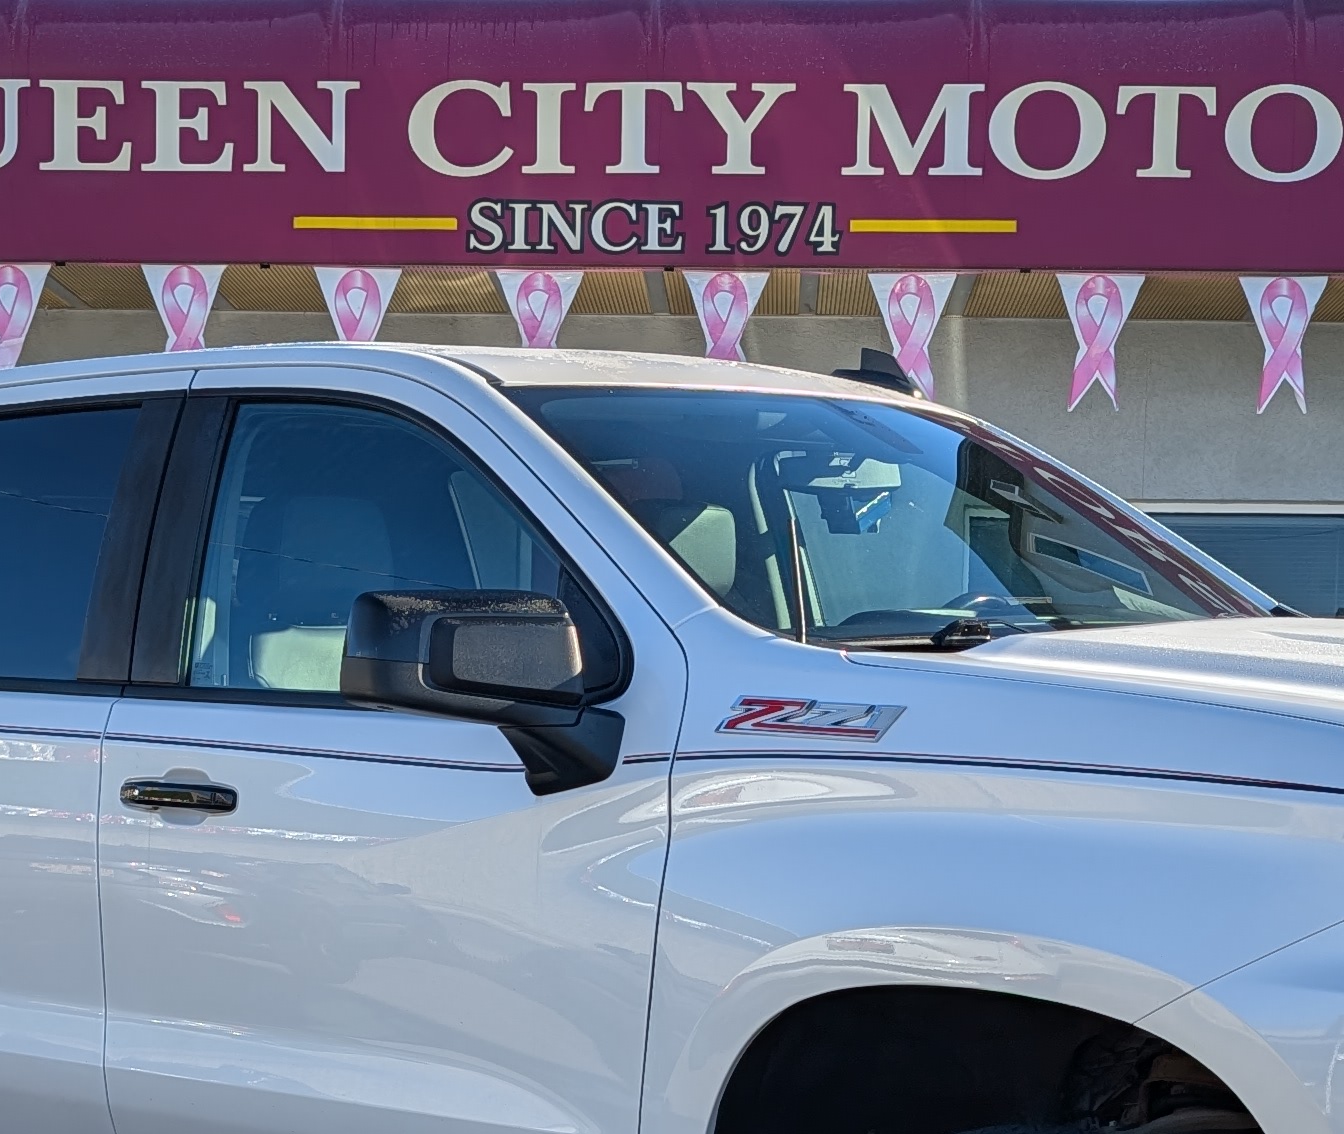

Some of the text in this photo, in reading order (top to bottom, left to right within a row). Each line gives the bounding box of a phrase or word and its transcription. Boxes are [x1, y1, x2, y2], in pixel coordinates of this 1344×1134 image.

[407, 80, 797, 178] CITY
[466, 198, 842, 256] SINCE 1974
[714, 694, 908, 743] Z71
